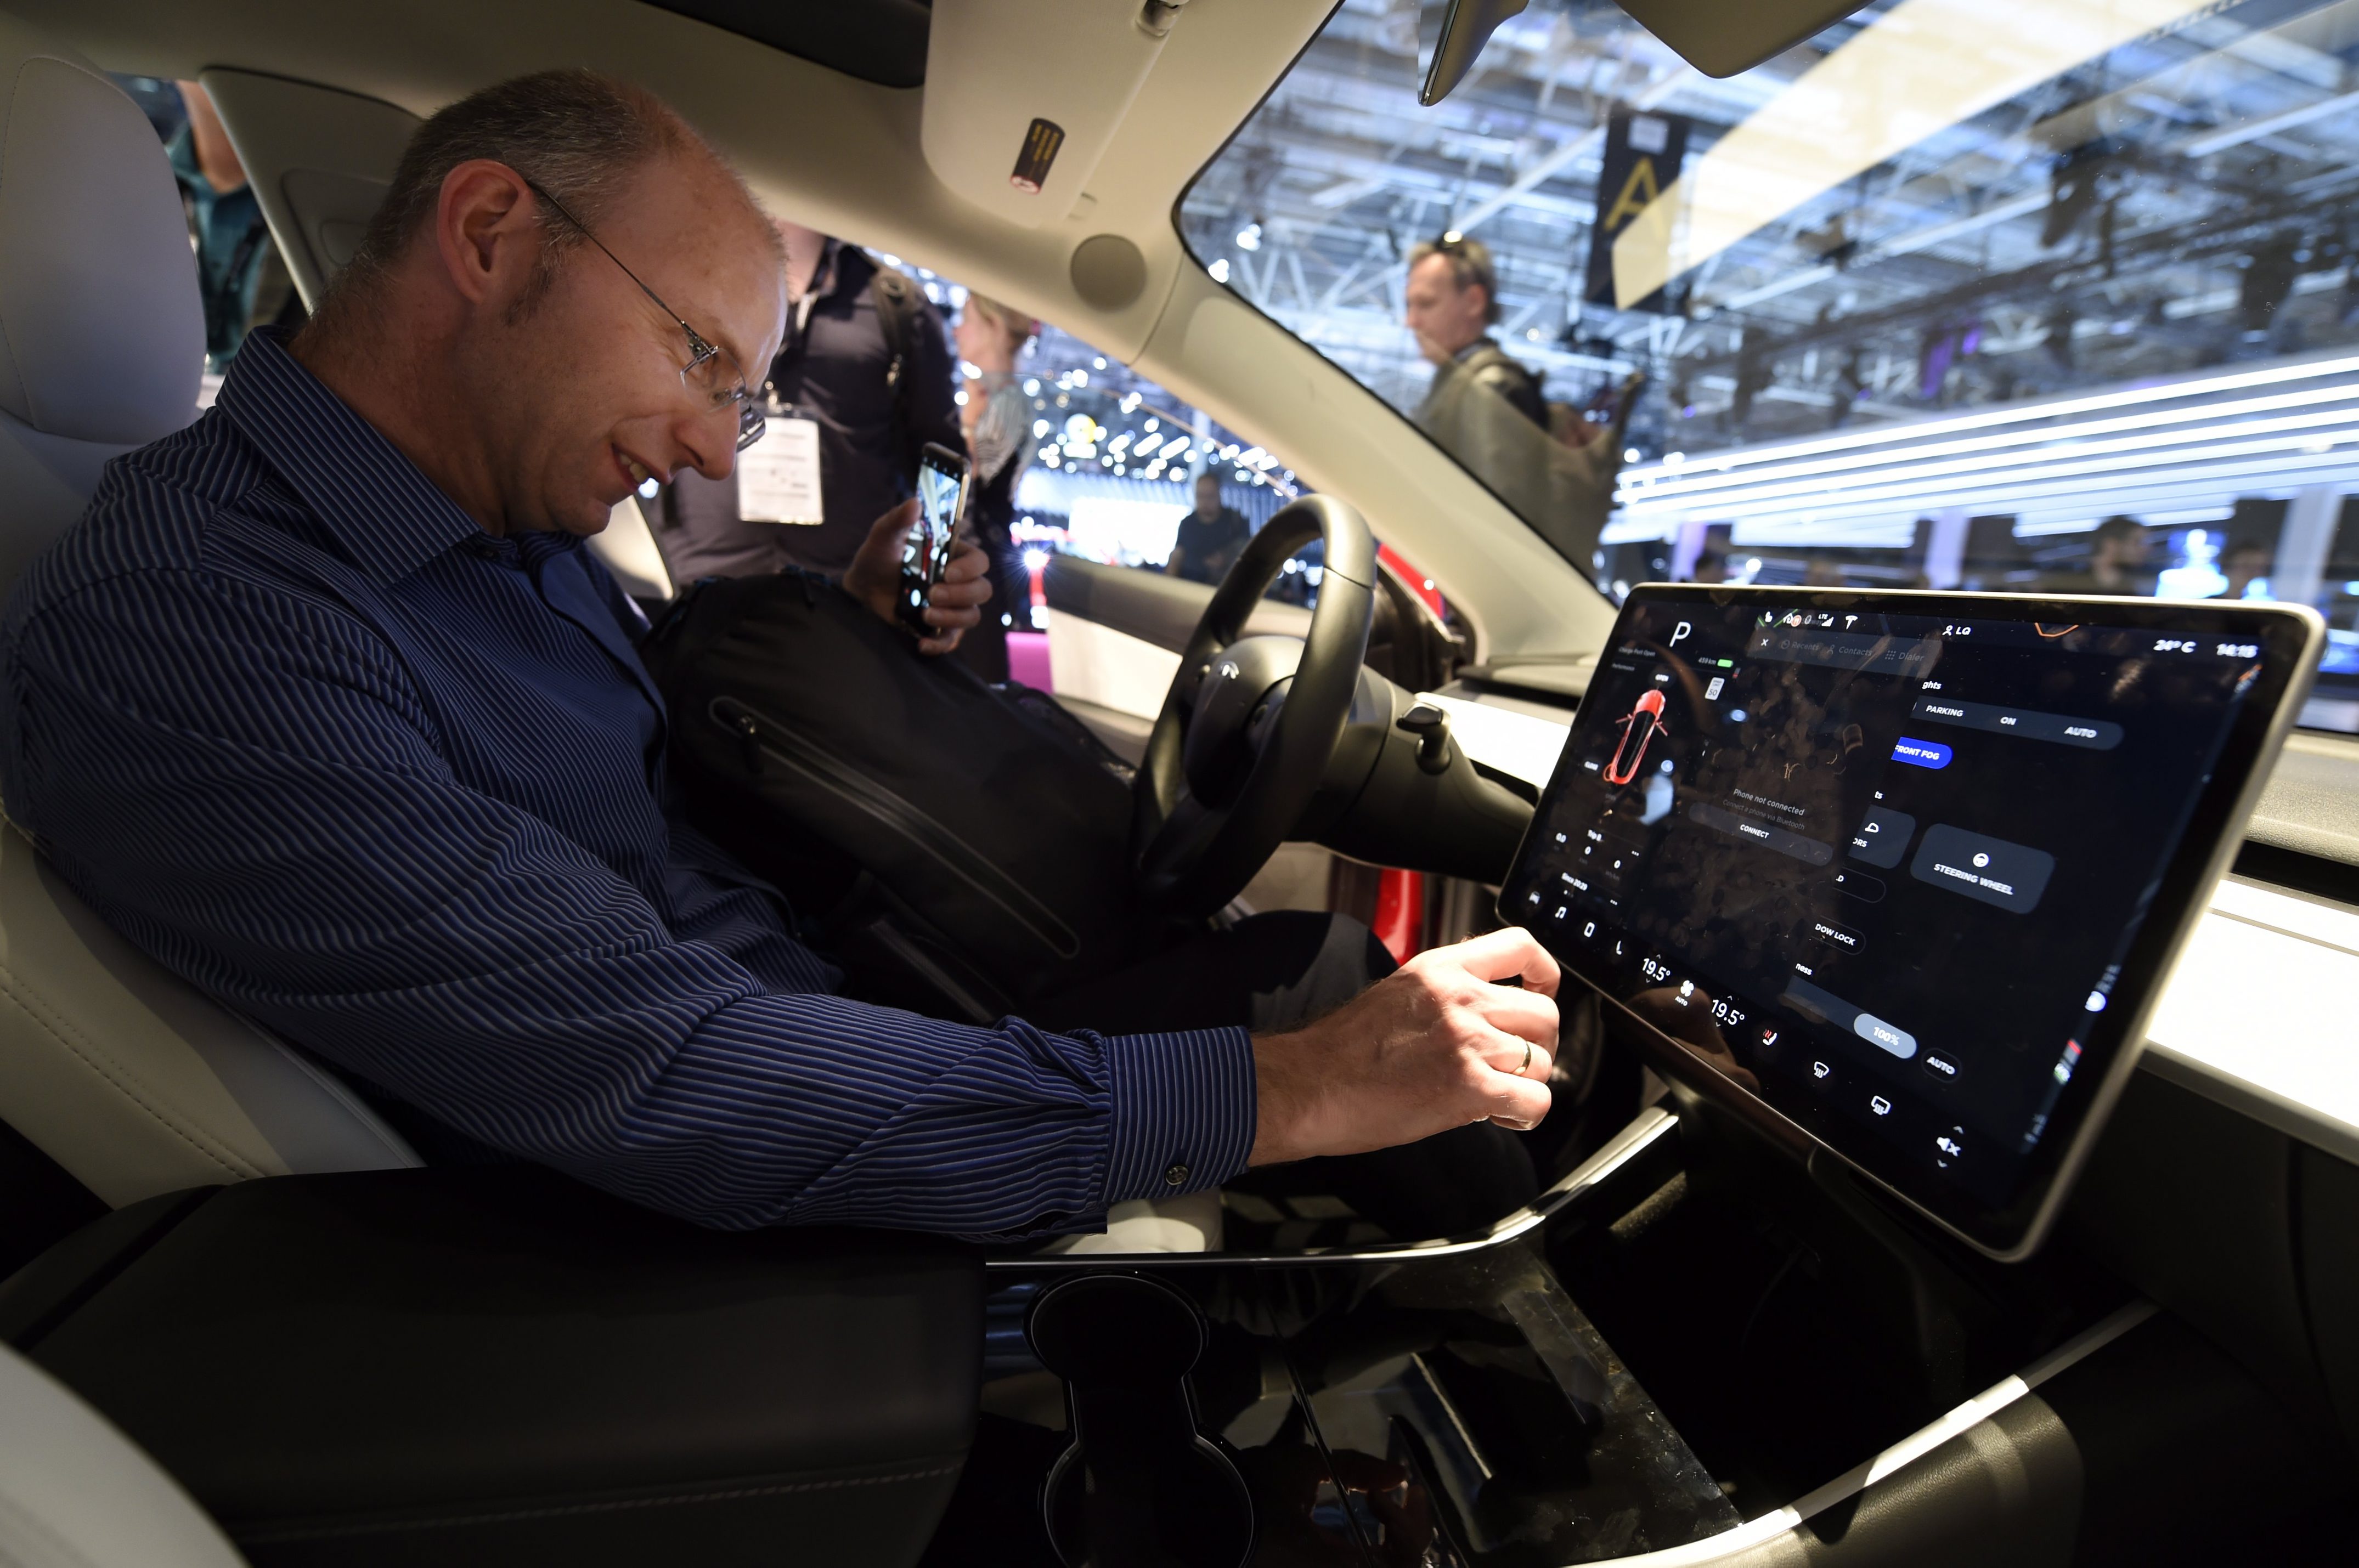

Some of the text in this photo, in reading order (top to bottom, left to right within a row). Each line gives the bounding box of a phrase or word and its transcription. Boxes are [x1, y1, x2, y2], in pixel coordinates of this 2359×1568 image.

[1604, 155, 1668, 240] A
[1669, 621, 1691, 648] P
[1791, 641, 1819, 650] Recents
[1838, 646, 1873, 656] Contacts
[1898, 652, 1925, 661] Dialer
[1926, 705, 1963, 717] PARKING
[2000, 716, 2017, 725] ON
[2064, 726, 2097, 738] AUTO
[1921, 750, 1940, 760] FOG
[1734, 789, 1805, 816] Phone not connected
[1723, 799, 1745, 810] Connect
[1748, 808, 1767, 818] phone
[1776, 816, 1805, 830] Bluetooth
[1740, 824, 1769, 839] CONNECT
[1933, 863, 2013, 895] STEERING WHEEL
[1815, 923, 1856, 946] DOW LOCK
[1796, 963, 1813, 975] ness
[1675, 996, 1688, 1006] AUTO
[1873, 1027, 1900, 1045] 100%
[1927, 1056, 1955, 1074] AUTO
